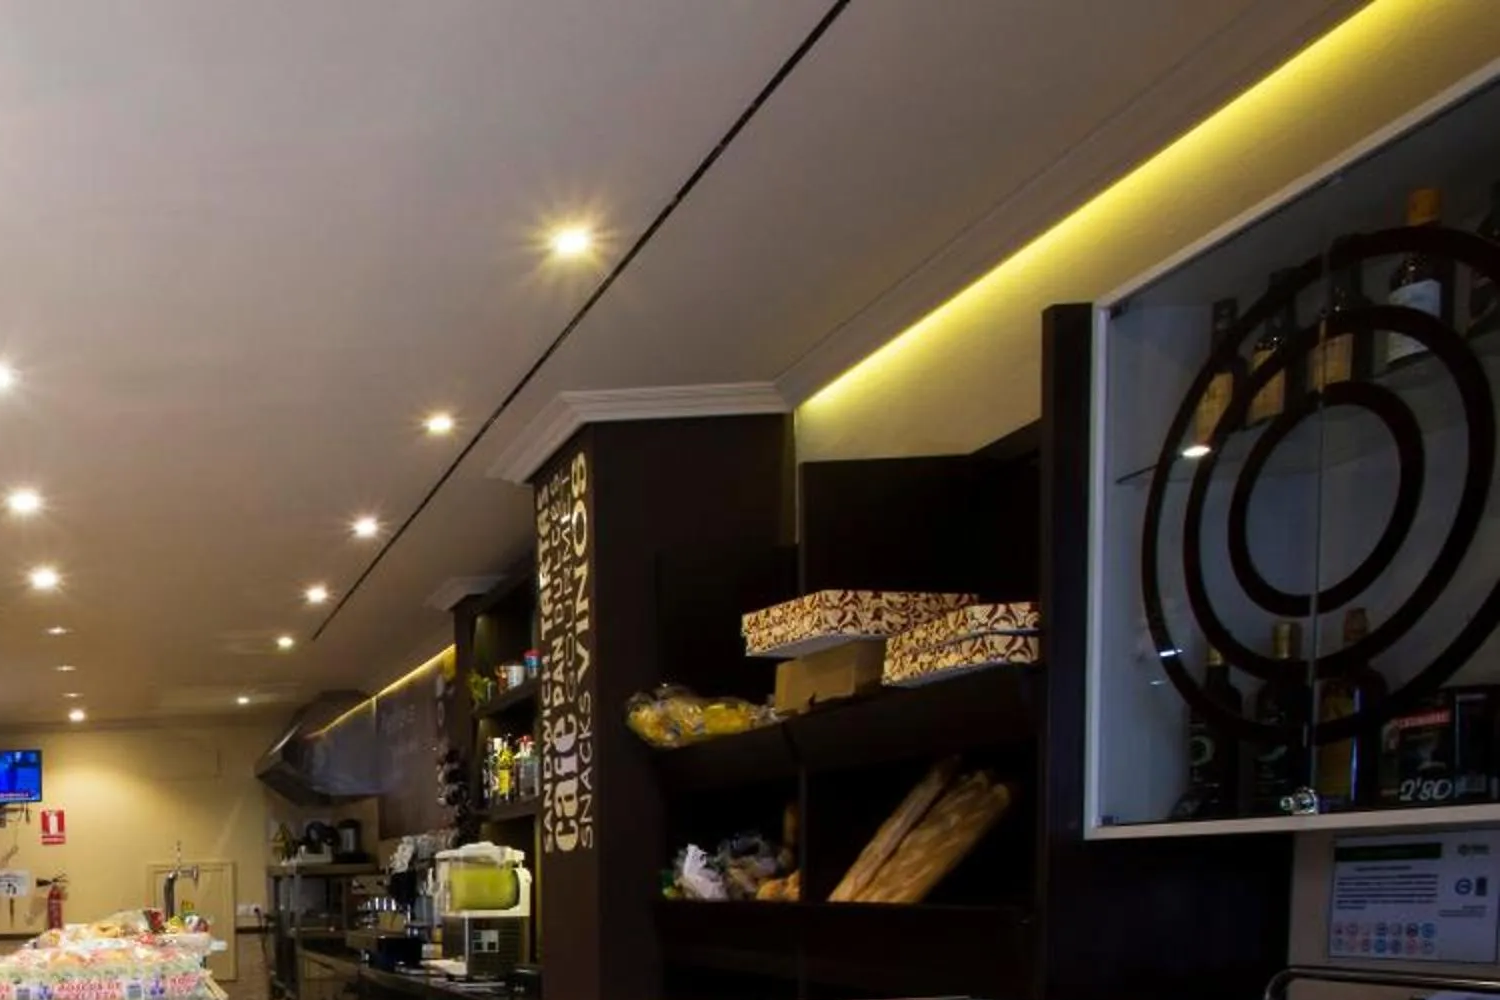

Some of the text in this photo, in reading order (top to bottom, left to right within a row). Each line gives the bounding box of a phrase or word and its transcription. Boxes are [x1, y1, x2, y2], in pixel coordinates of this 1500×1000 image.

[552, 637, 565, 707] PAN
[571, 452, 593, 849] SNACKS VINOS
[542, 655, 554, 853] SANDWICH
